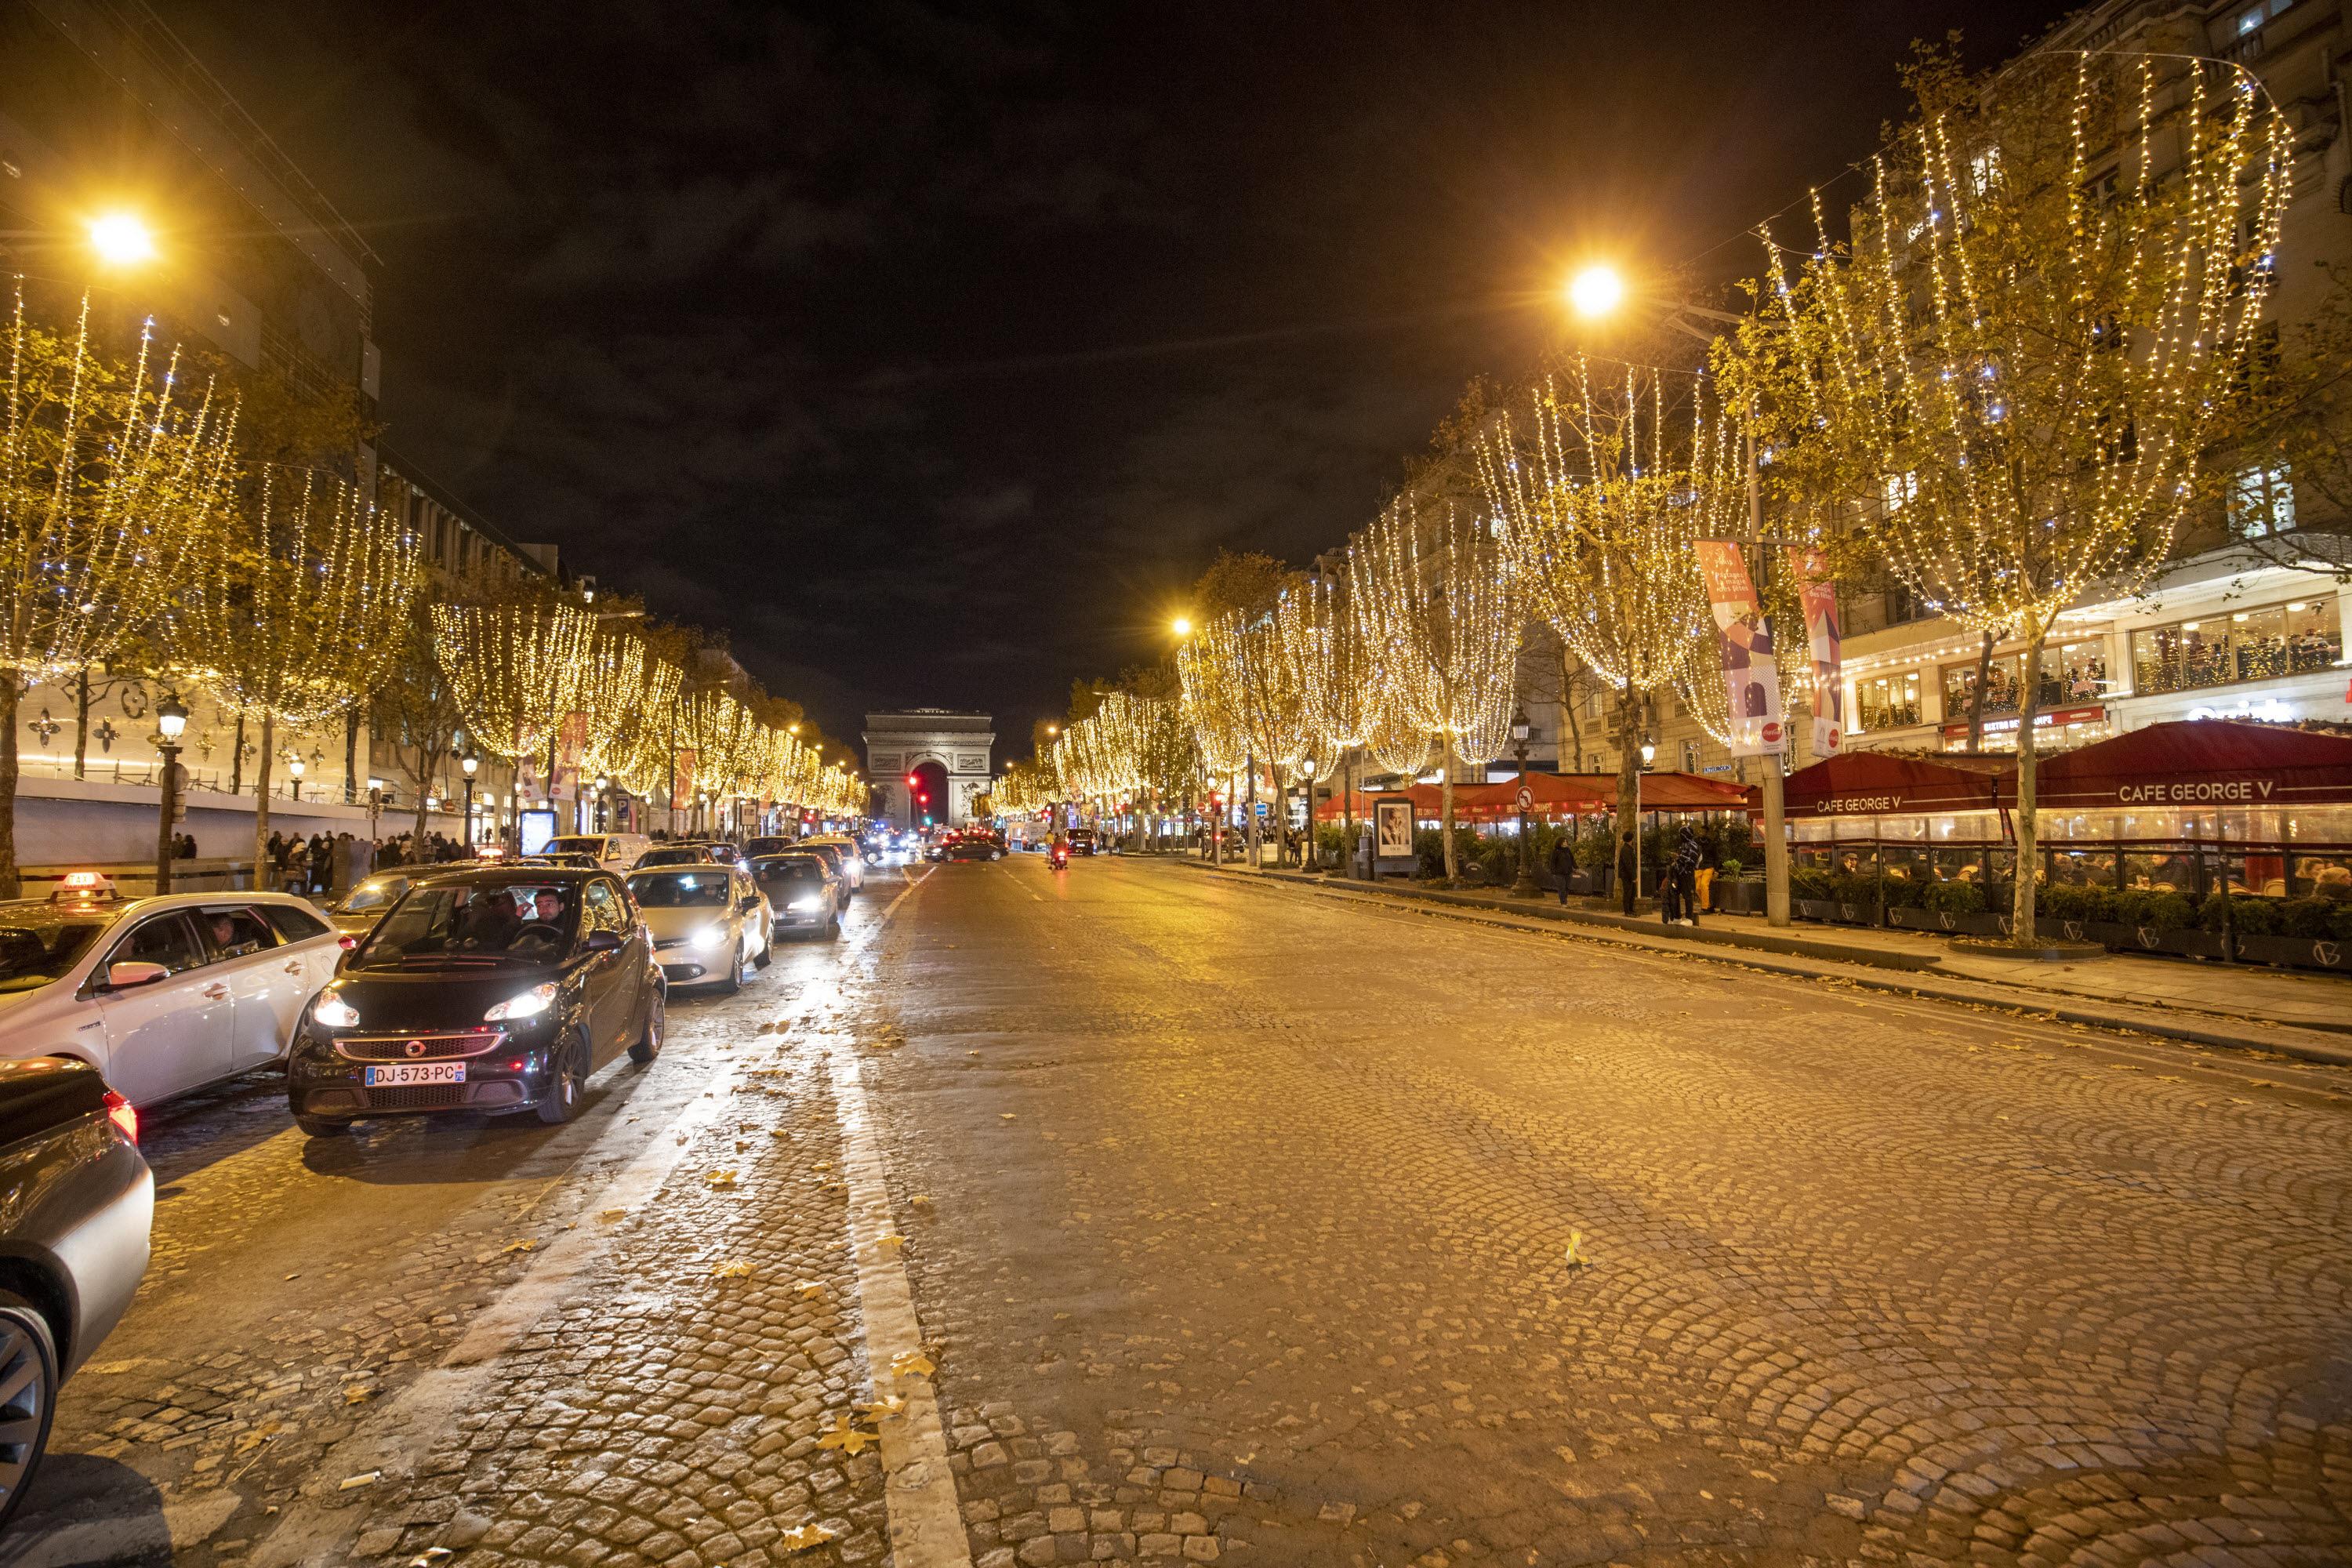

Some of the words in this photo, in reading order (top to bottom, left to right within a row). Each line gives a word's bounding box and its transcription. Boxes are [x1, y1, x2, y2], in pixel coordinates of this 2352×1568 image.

[2119, 785, 2166, 802] CAFE
[2171, 782, 2252, 800] GEORGE
[2257, 781, 2274, 798] V
[1817, 800, 1843, 812] CAFE
[1845, 797, 1890, 811] GEORGE
[1892, 796, 1901, 808] V
[376, 1065, 454, 1083] DJ-573-PC
[455, 1073, 464, 1081] 75
